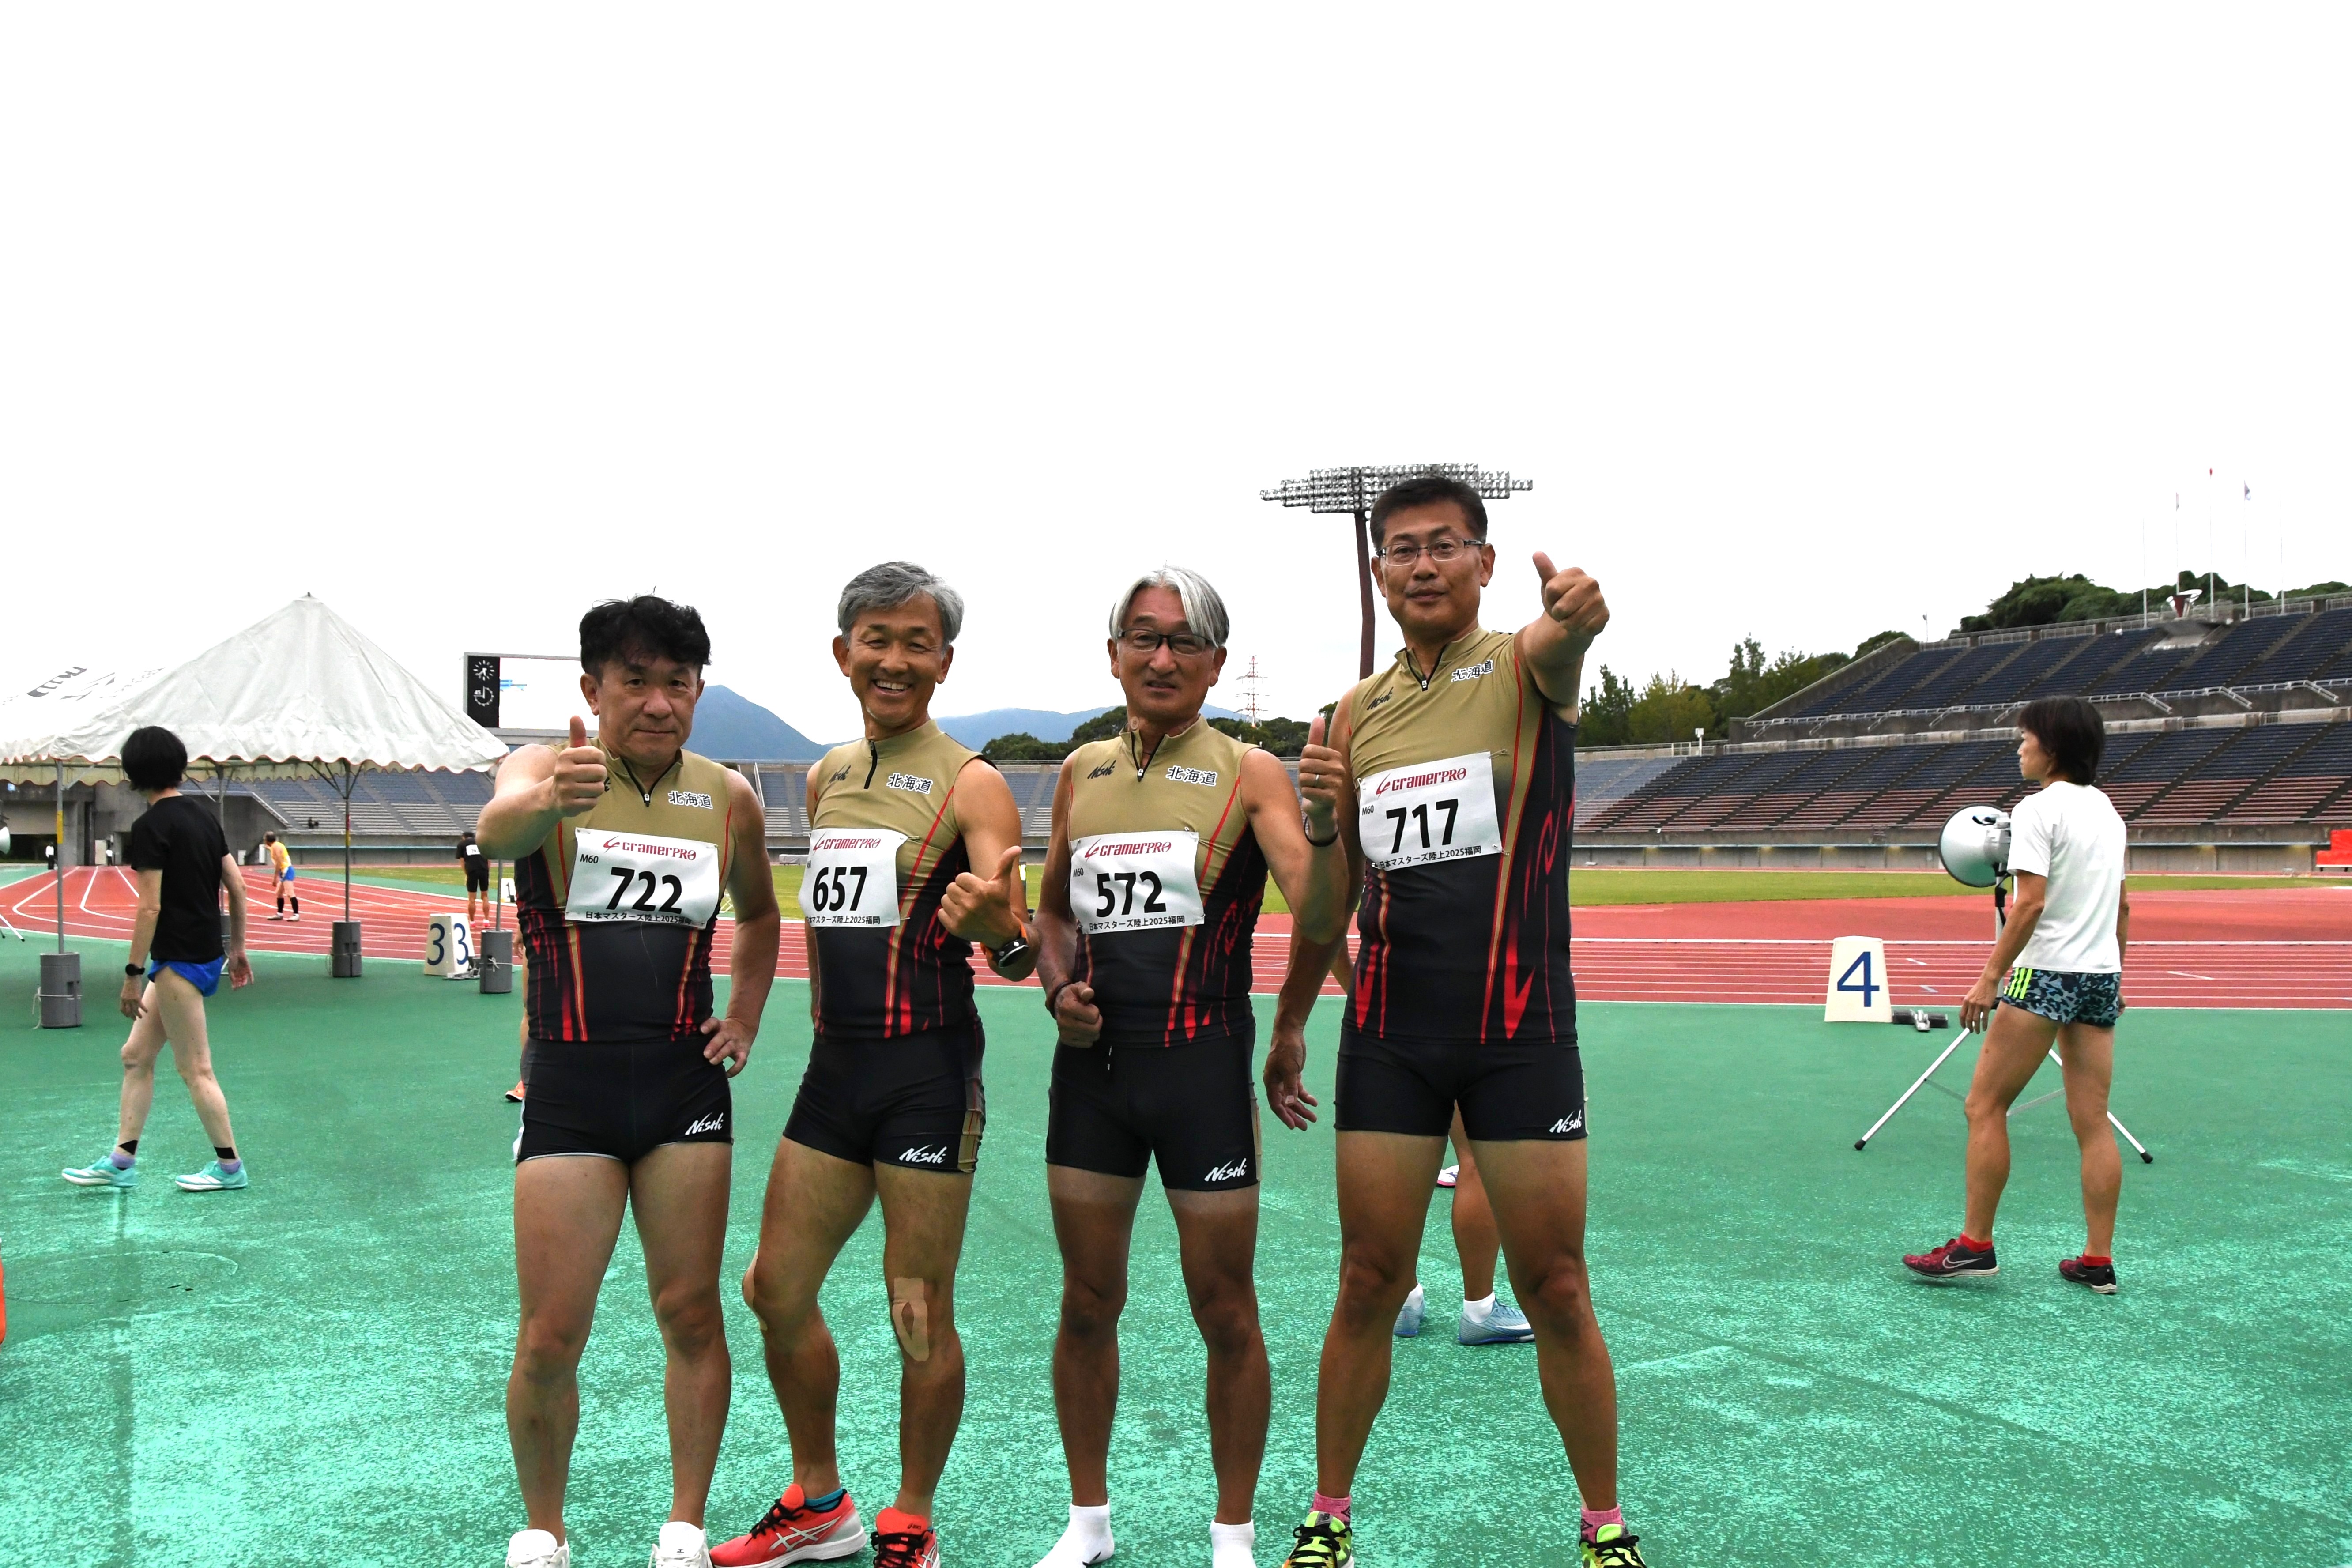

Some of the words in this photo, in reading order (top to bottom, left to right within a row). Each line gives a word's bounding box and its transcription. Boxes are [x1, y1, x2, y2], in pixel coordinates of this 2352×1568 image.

[1451, 660, 1493, 682] 北海道
[886, 773, 933, 795] 北海道
[1166, 765, 1218, 787] 北海道
[668, 791, 713, 809] 北海道
[1362, 805, 1374, 816] M60
[1386, 799, 1459, 854] 717
[580, 854, 599, 864] M60
[1380, 846, 1482, 868] 日本マスターズ陸上2025福岡
[1073, 867, 1084, 878] M60
[606, 867, 682, 914] 722
[813, 866, 867, 912] 657
[1096, 871, 1167, 918] 572
[1089, 915, 1185, 931] 日本マスターズ陸上2025福岡
[427, 923, 445, 965] 3
[454, 923, 469, 965] 3
[1837, 951, 1880, 1007] 4
